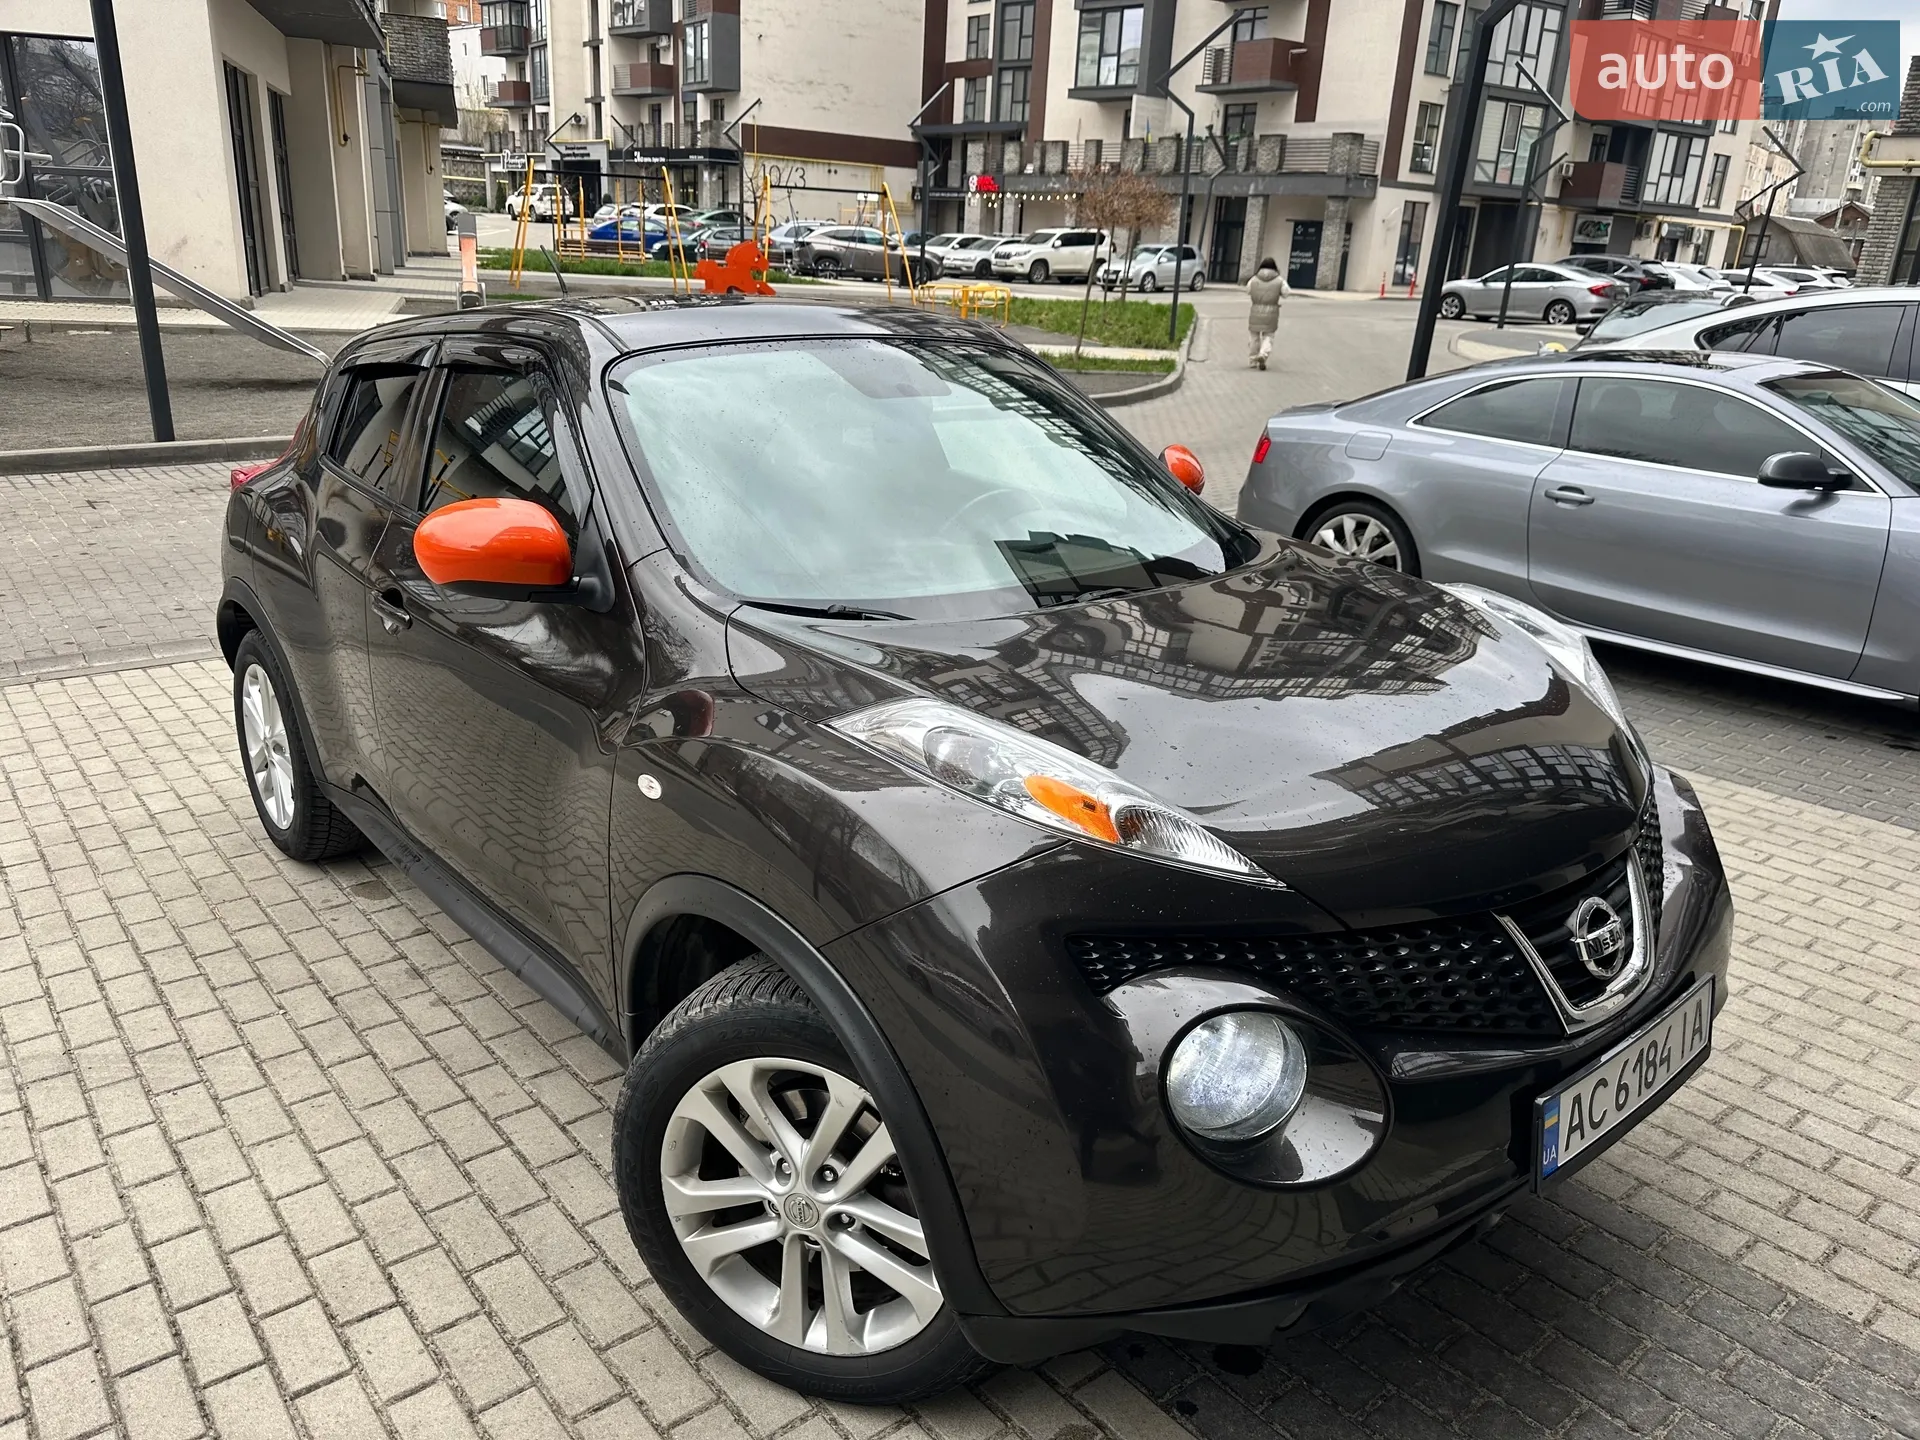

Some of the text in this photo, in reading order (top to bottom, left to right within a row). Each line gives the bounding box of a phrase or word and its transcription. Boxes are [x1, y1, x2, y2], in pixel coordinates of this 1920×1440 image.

[762, 164, 806, 188] 10/3
[1564, 999, 1704, 1153] AC 6184 IA
[1543, 1150, 1557, 1165] UA
